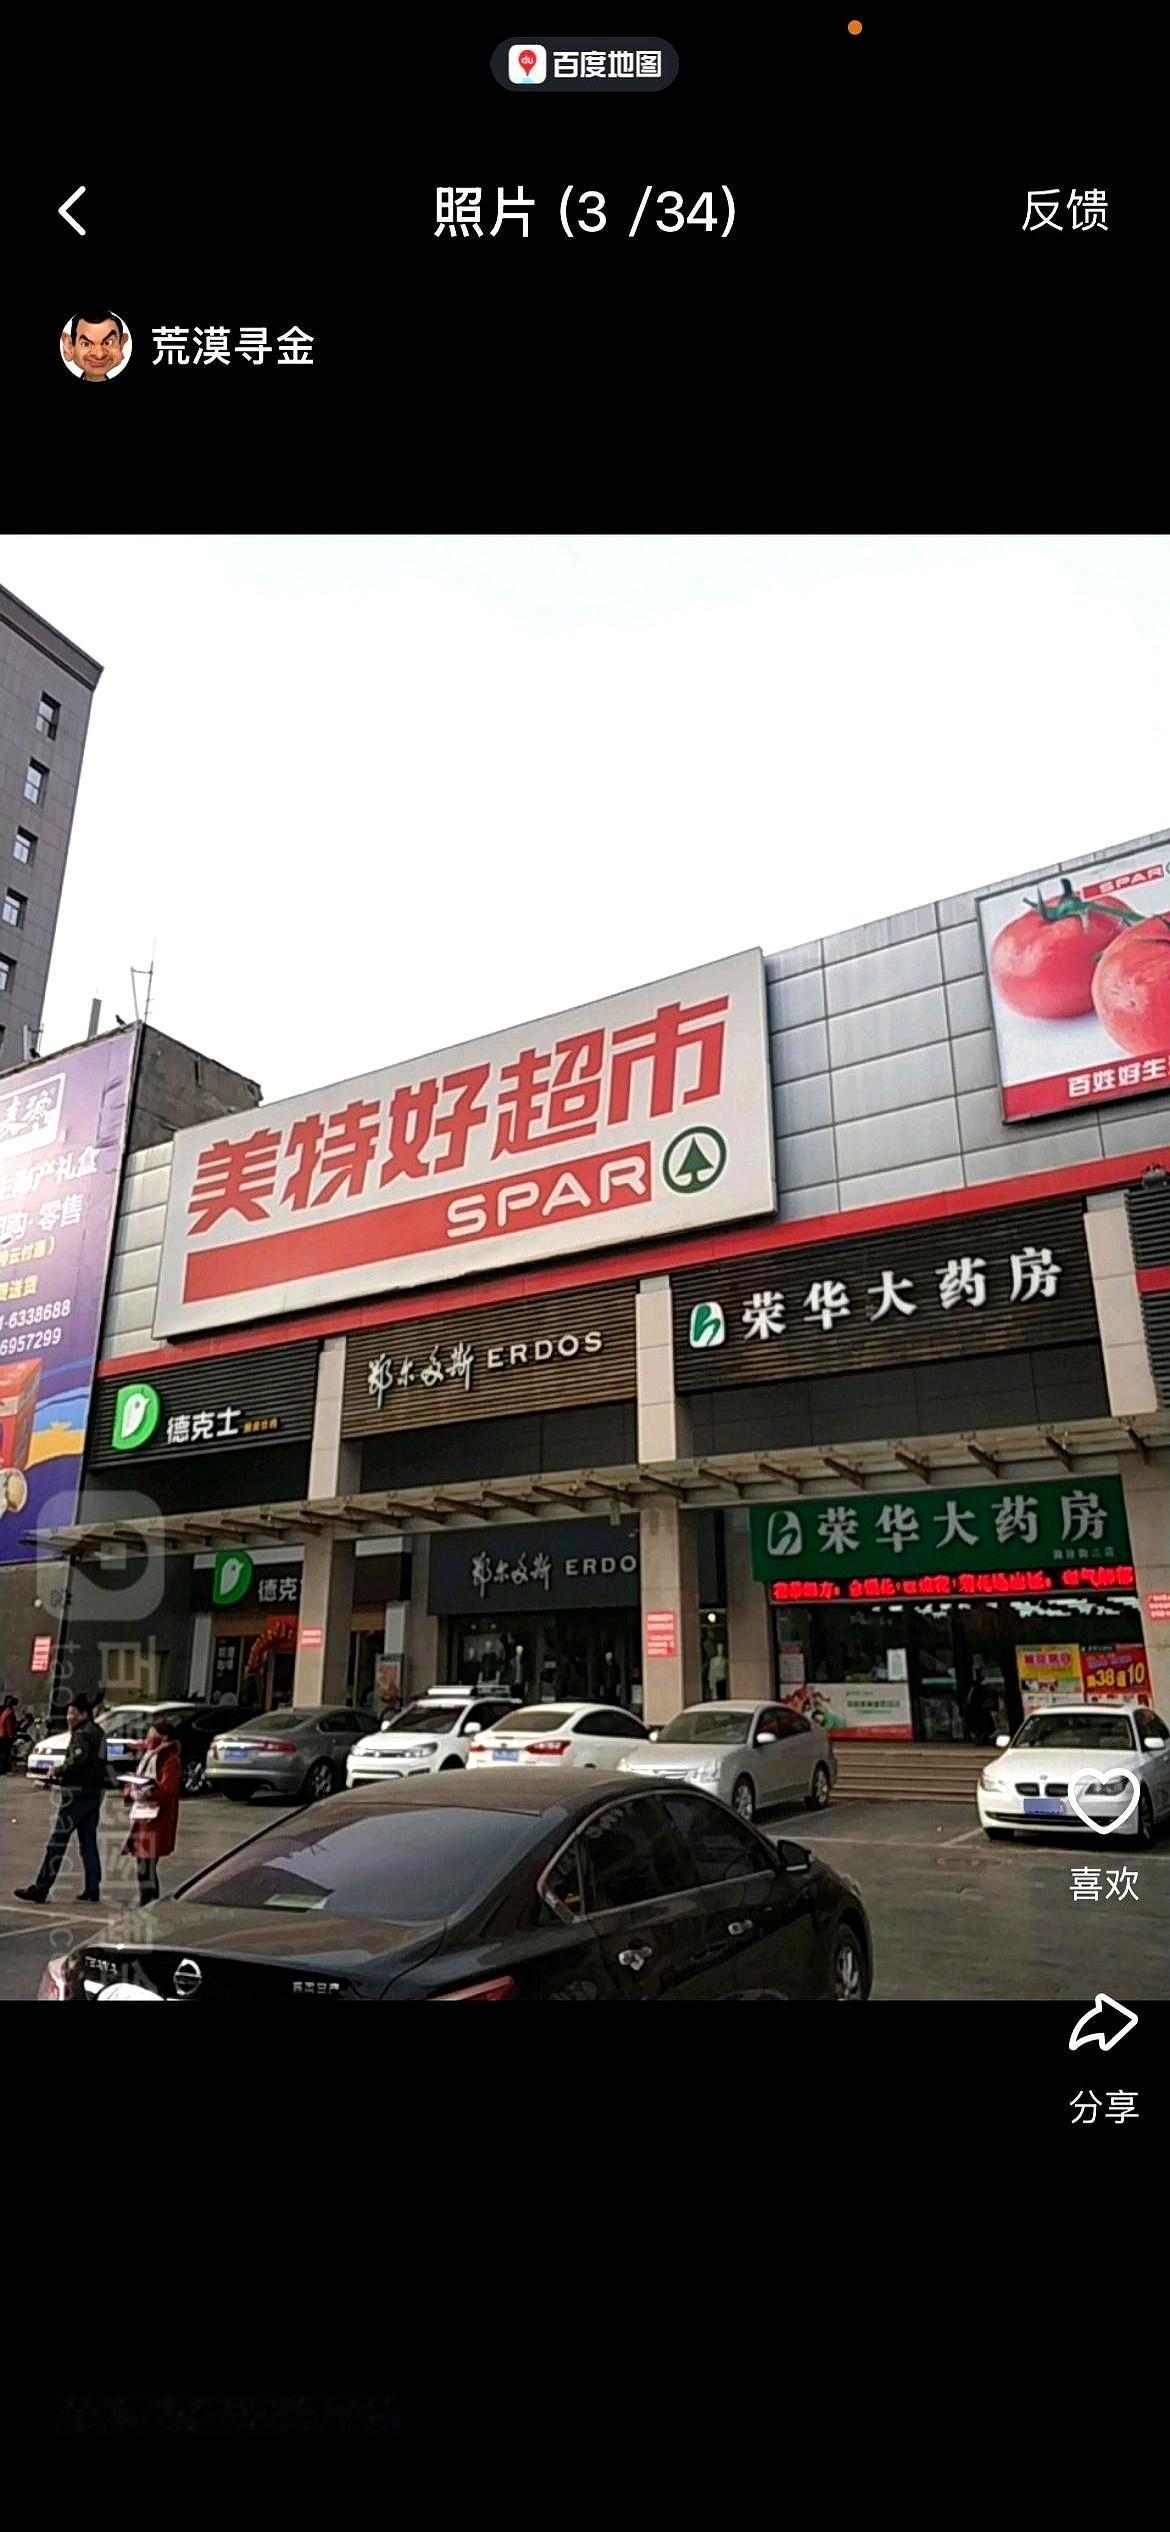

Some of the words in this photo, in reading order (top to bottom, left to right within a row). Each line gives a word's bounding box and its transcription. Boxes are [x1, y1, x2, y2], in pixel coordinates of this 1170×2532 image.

[1099, 866, 1163, 894] SPAR
[187, 995, 730, 1236] 美特好超市
[446, 1157, 647, 1239] SPAR
[742, 1247, 1062, 1341] 荣华大药房
[487, 1331, 602, 1369] ERDOS
[167, 1406, 241, 1445] 德克士
[816, 1490, 1108, 1555] 荣华大药房
[566, 1555, 637, 1575] ERDO
[258, 1576, 303, 1602] 德克
